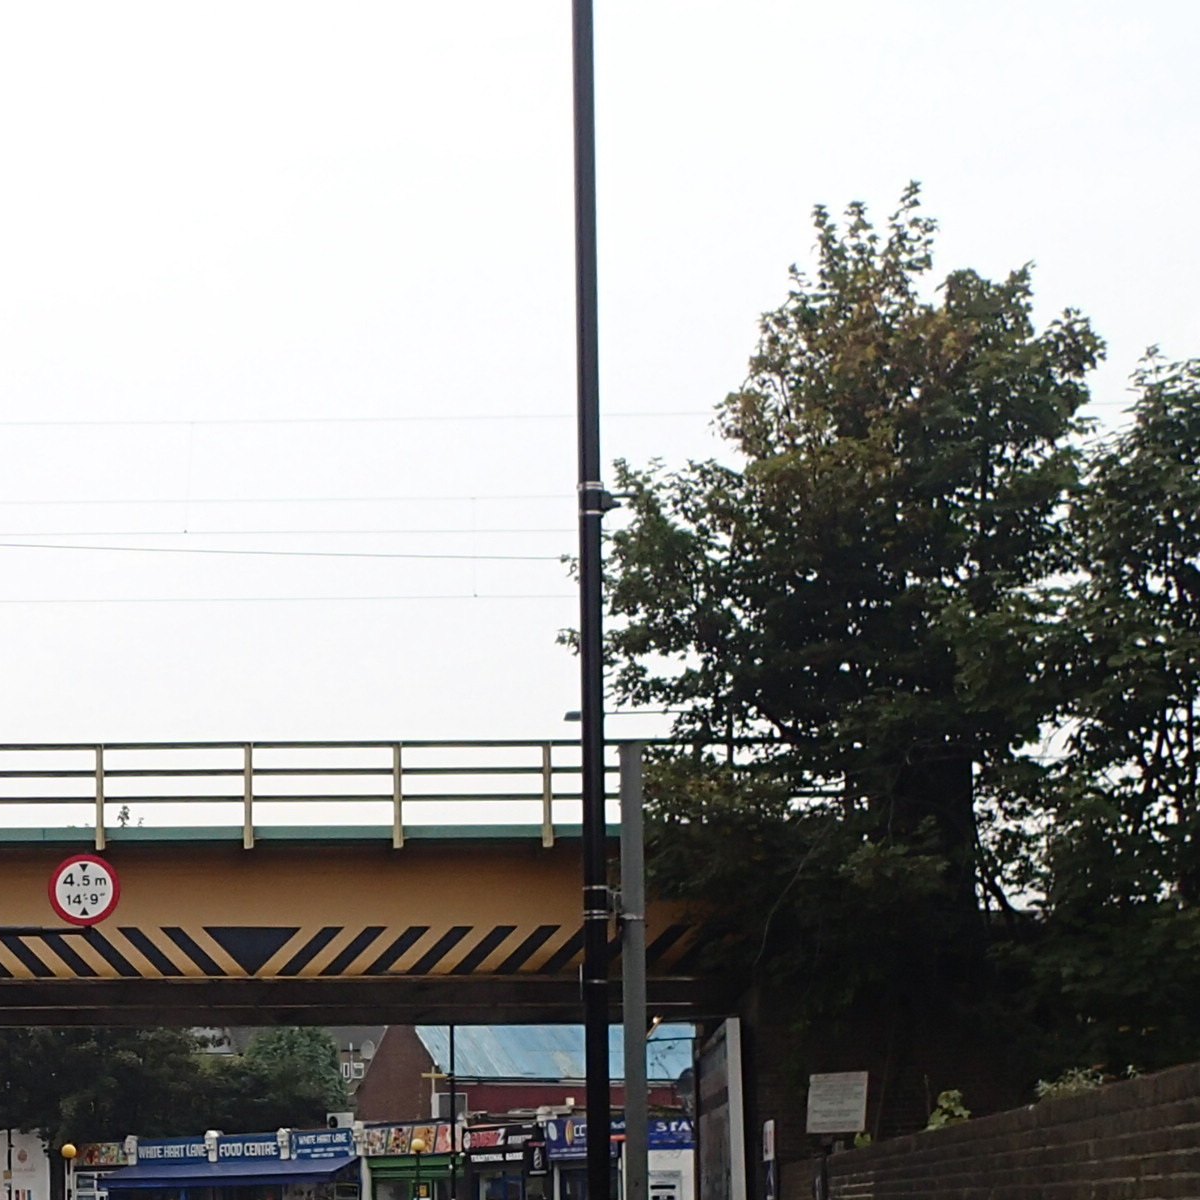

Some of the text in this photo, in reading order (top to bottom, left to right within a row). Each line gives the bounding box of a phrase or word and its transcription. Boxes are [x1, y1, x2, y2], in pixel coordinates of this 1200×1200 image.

[63, 873, 107, 887] 4.5 m
[655, 1121, 694, 1132] STA
[138, 1142, 277, 1159] WHITE HART LANE FOOD CENTRE
